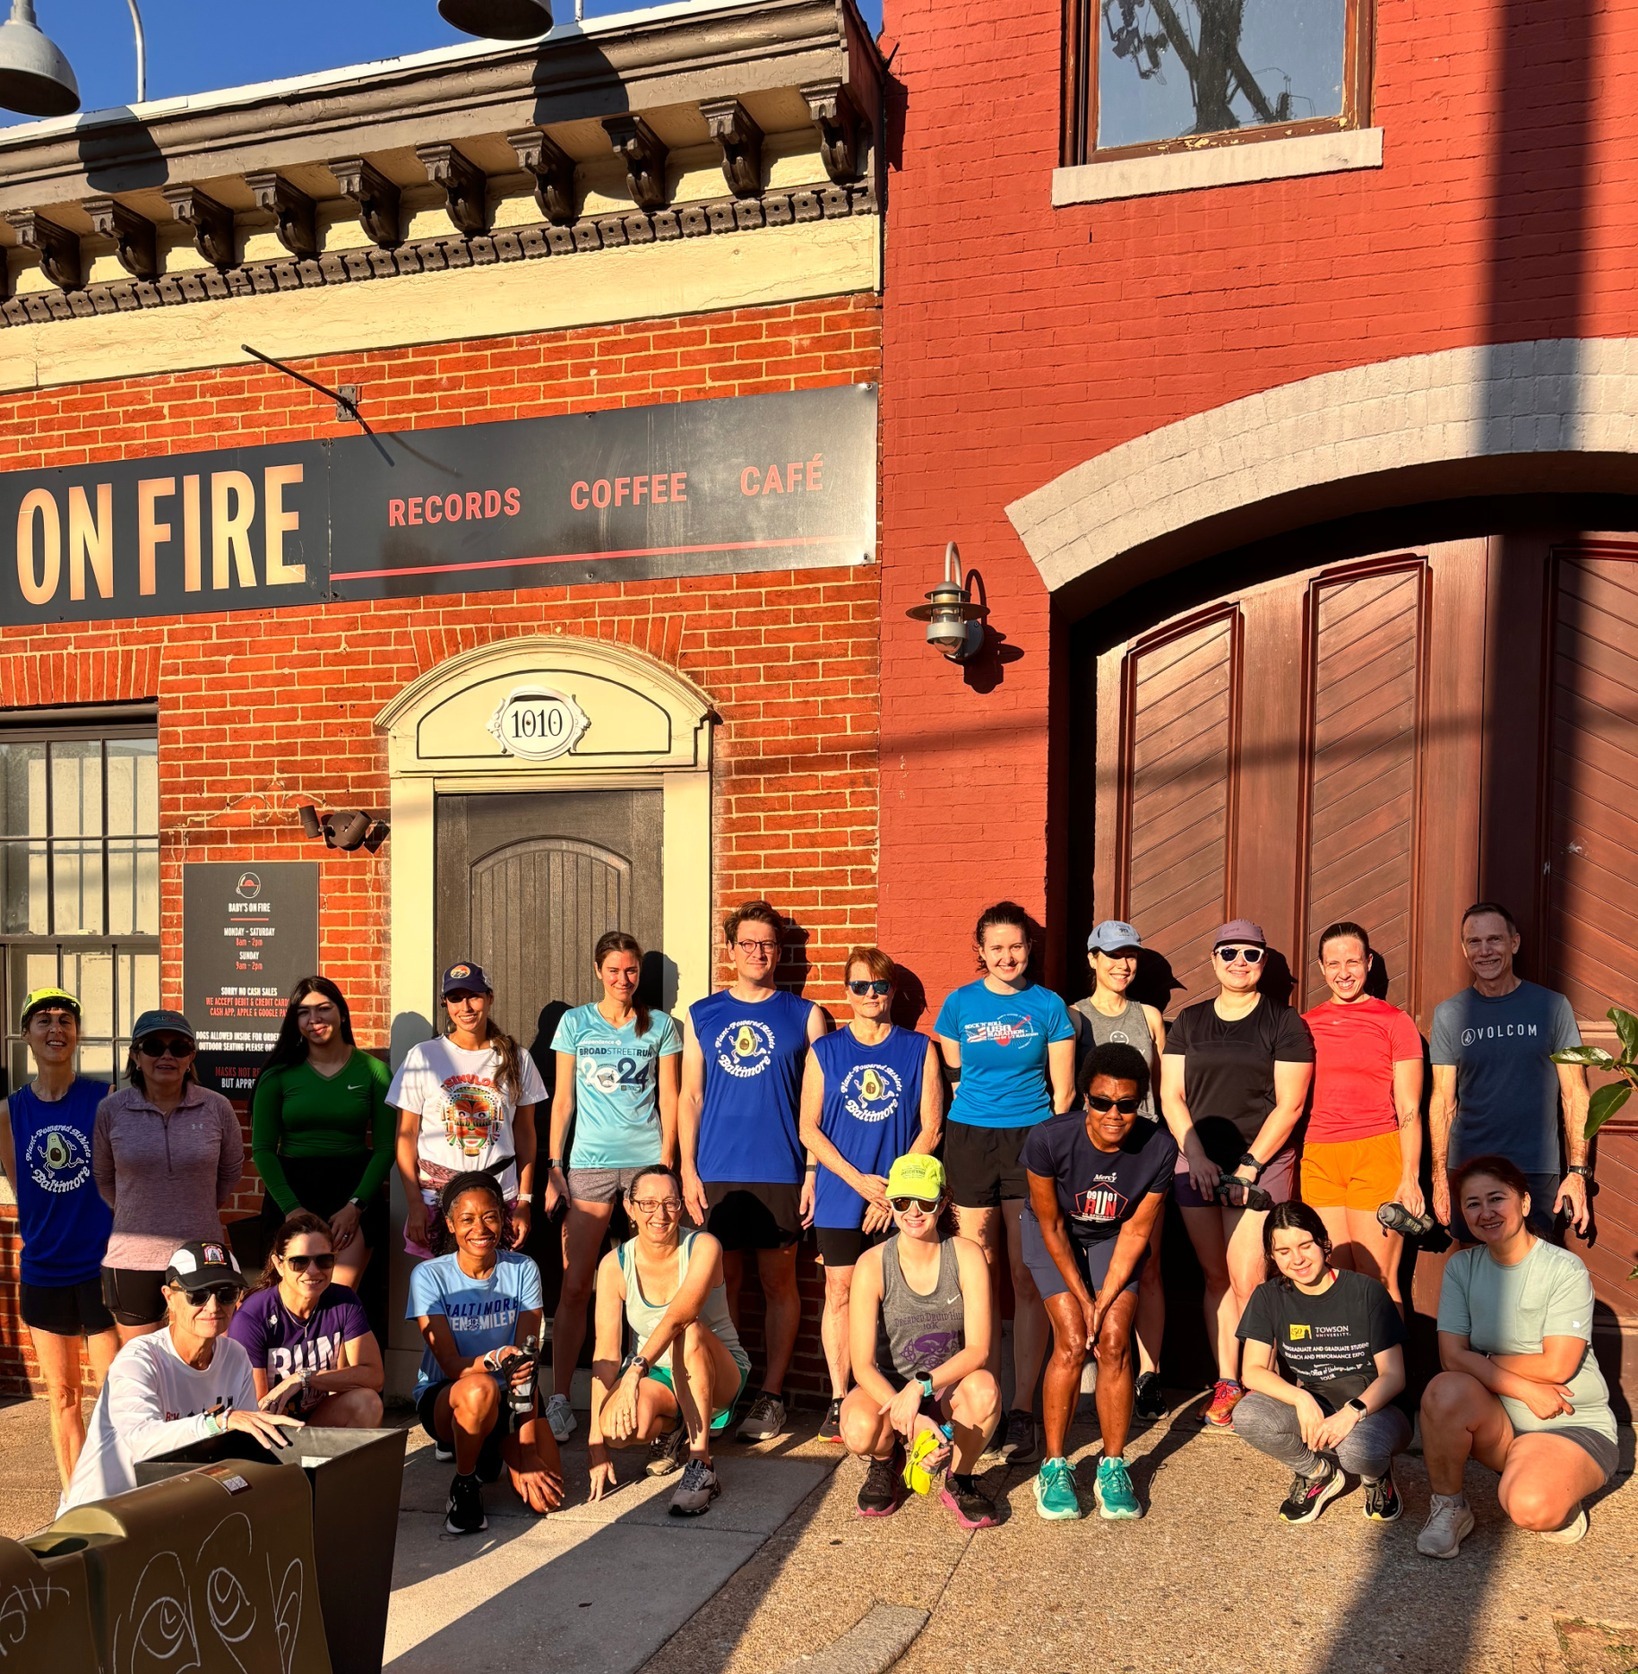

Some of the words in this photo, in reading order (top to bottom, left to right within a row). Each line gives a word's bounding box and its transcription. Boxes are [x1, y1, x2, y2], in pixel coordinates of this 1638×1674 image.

[739, 452, 823, 496] CAFÉ
[570, 471, 688, 511] COFFEE
[388, 486, 521, 527] RECORDS
[16, 482, 114, 605] ON
[138, 463, 306, 596] FIRE
[511, 708, 563, 738] 1010
[228, 902, 248, 912] BABY'S
[248, 902, 257, 912] ON
[257, 902, 271, 912] FIRE
[223, 927, 245, 936] MONDAY
[249, 927, 276, 937] SATURDAY
[251, 937, 264, 948] 2pm
[239, 951, 260, 960] SUNDAY
[235, 961, 247, 970] 9am
[251, 961, 264, 971] 2pm
[221, 986, 238, 996] SORRY
[238, 986, 246, 996] NO
[247, 987, 261, 996] CASH
[261, 987, 278, 996] SALES
[205, 997, 213, 1006] WE
[214, 997, 233, 1006] ACCEPT
[234, 997, 249, 1006] DEBIT
[255, 997, 273, 1007] CREDIT
[274, 998, 290, 1007] CARD
[209, 1007, 223, 1017] CASH
[237, 1008, 252, 1017] APPLE
[258, 1008, 278, 1018] GOOGLE
[279, 1008, 287, 1018] PA
[195, 1030, 209, 1040] DOGS
[210, 1031, 233, 1041] ALLOWED
[233, 1031, 251, 1041] INSIDE
[252, 1032, 262, 1041] FOR
[1477, 1023, 1537, 1040] VOLCOM
[198, 1041, 222, 1051] OUTDOOR
[223, 1042, 245, 1052] SEATING
[245, 1042, 264, 1052] PLEASE
[215, 1066, 237, 1077] MASKS
[238, 1066, 250, 1077] NOT
[718, 1054, 771, 1078] Baltimore
[221, 1077, 235, 1088] BUT
[845, 1098, 899, 1122] Baltimore
[31, 1166, 90, 1193] Baltimore
[1093, 1173, 1118, 1183] Mercy
[446, 1295, 519, 1317] BALTIMORE
[479, 1309, 516, 1331] MILER
[1314, 1325, 1349, 1334] TOWSON
[267, 1331, 341, 1390] RUN
[1315, 1352, 1352, 1360] PERFORMANCE
[1352, 1351, 1366, 1359] EXPO
